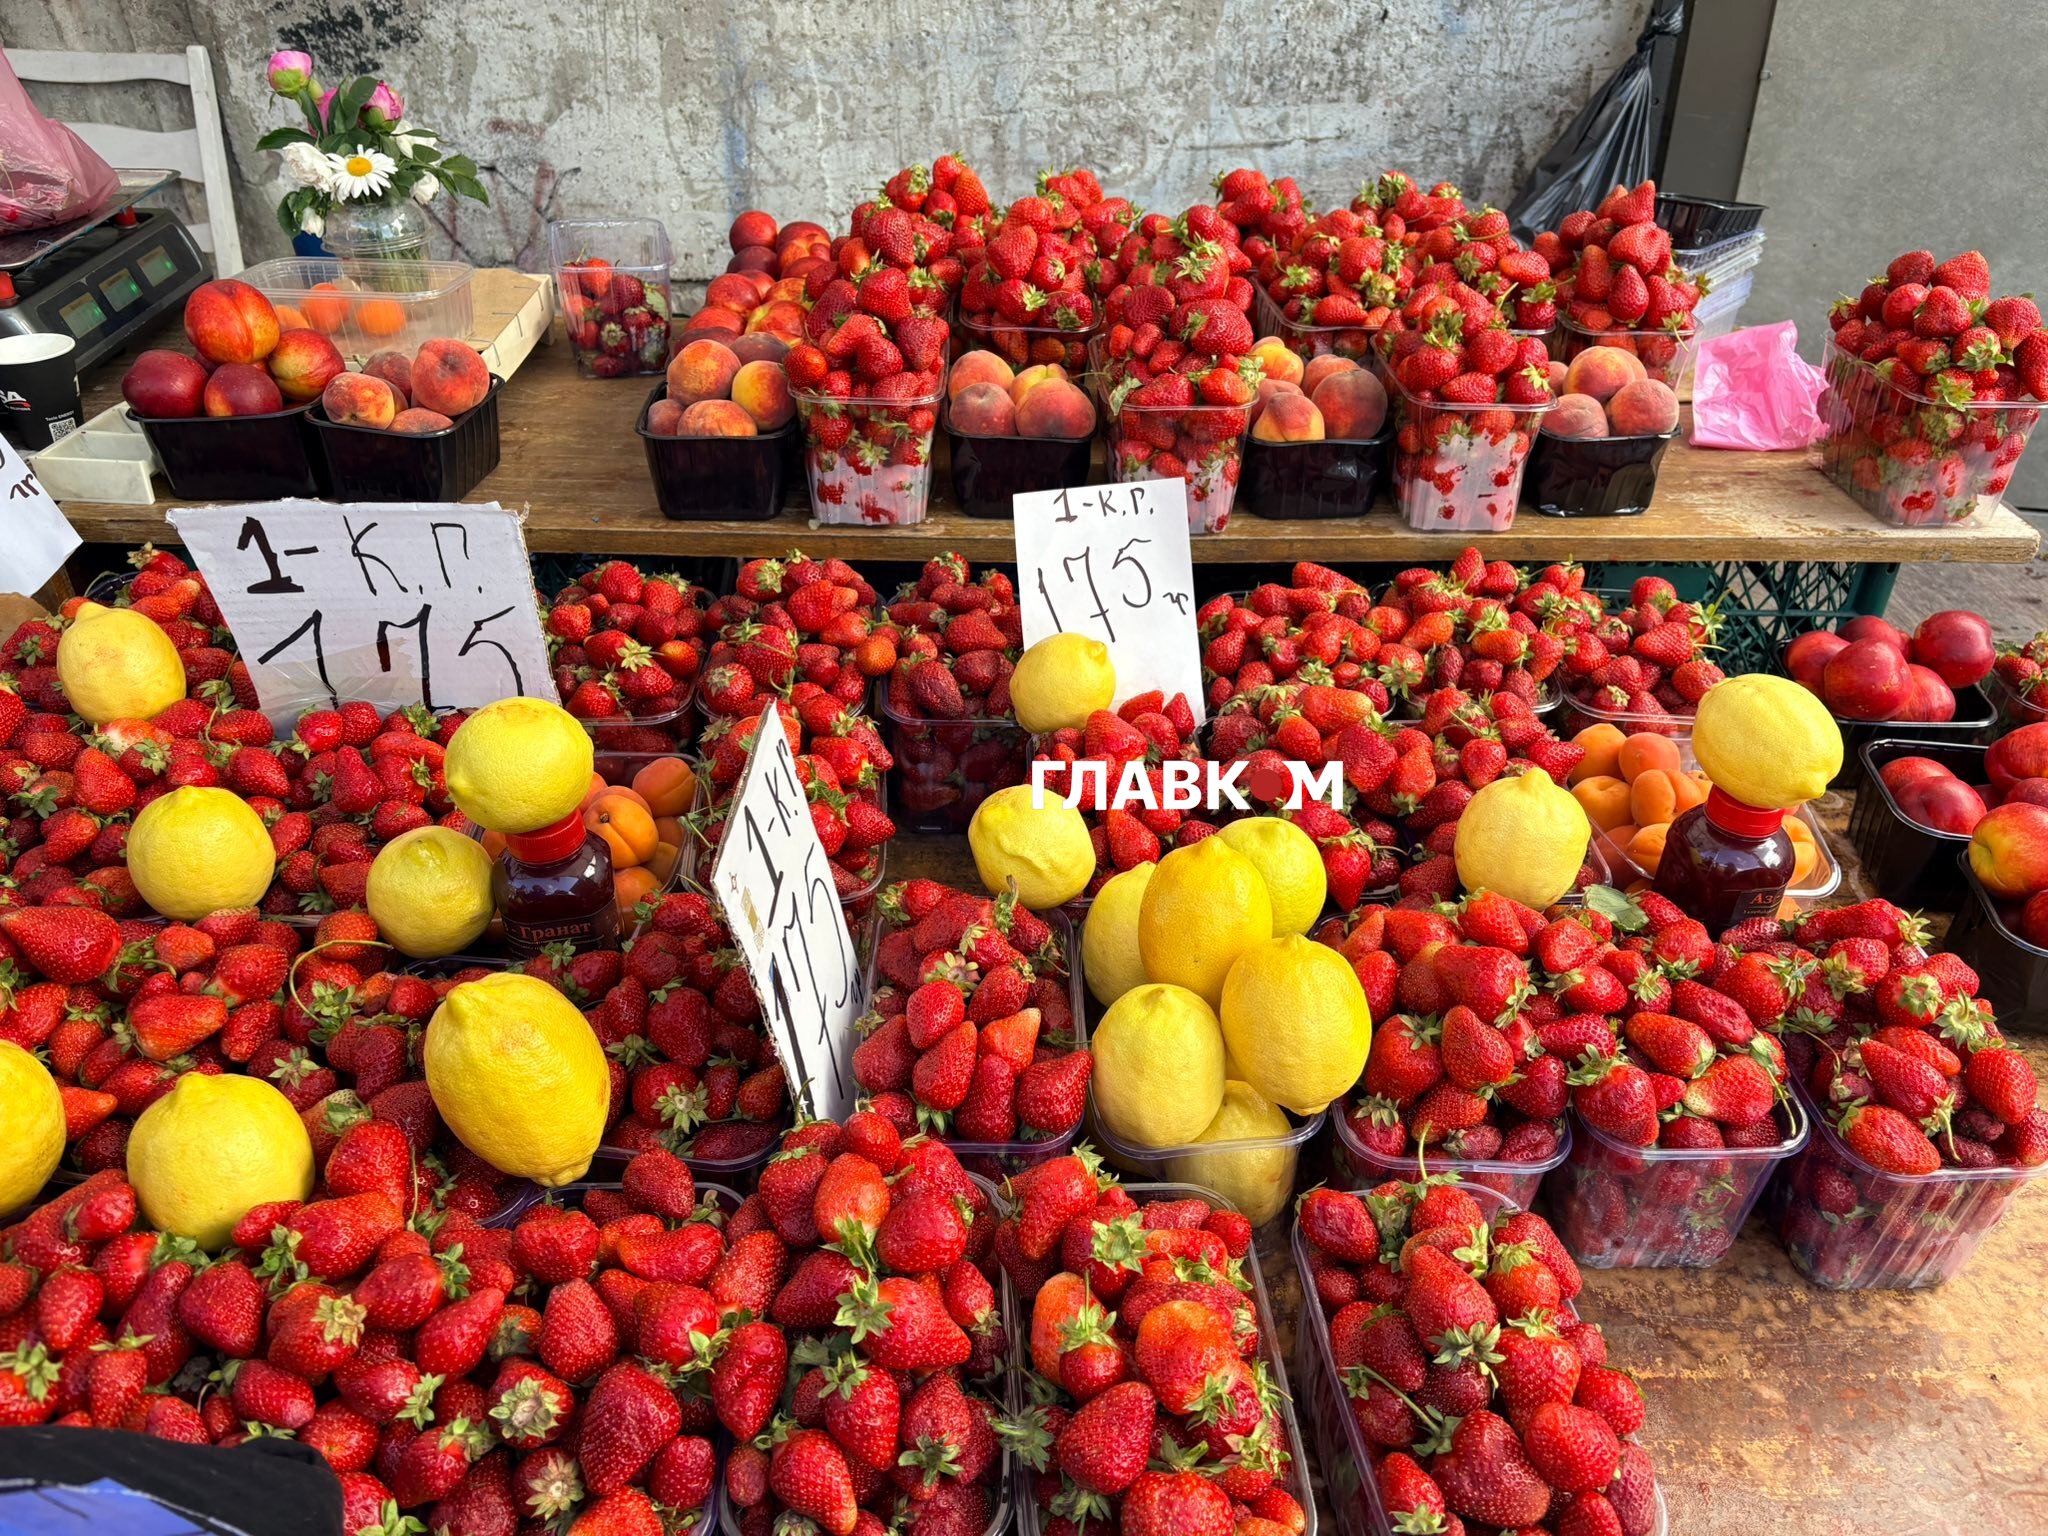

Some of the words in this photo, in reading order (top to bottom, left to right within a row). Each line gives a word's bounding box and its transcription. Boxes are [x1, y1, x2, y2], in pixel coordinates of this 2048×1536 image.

[1037, 538, 1152, 643] 175
[257, 604, 525, 714] 175
[519, 922, 591, 944] Гранат
